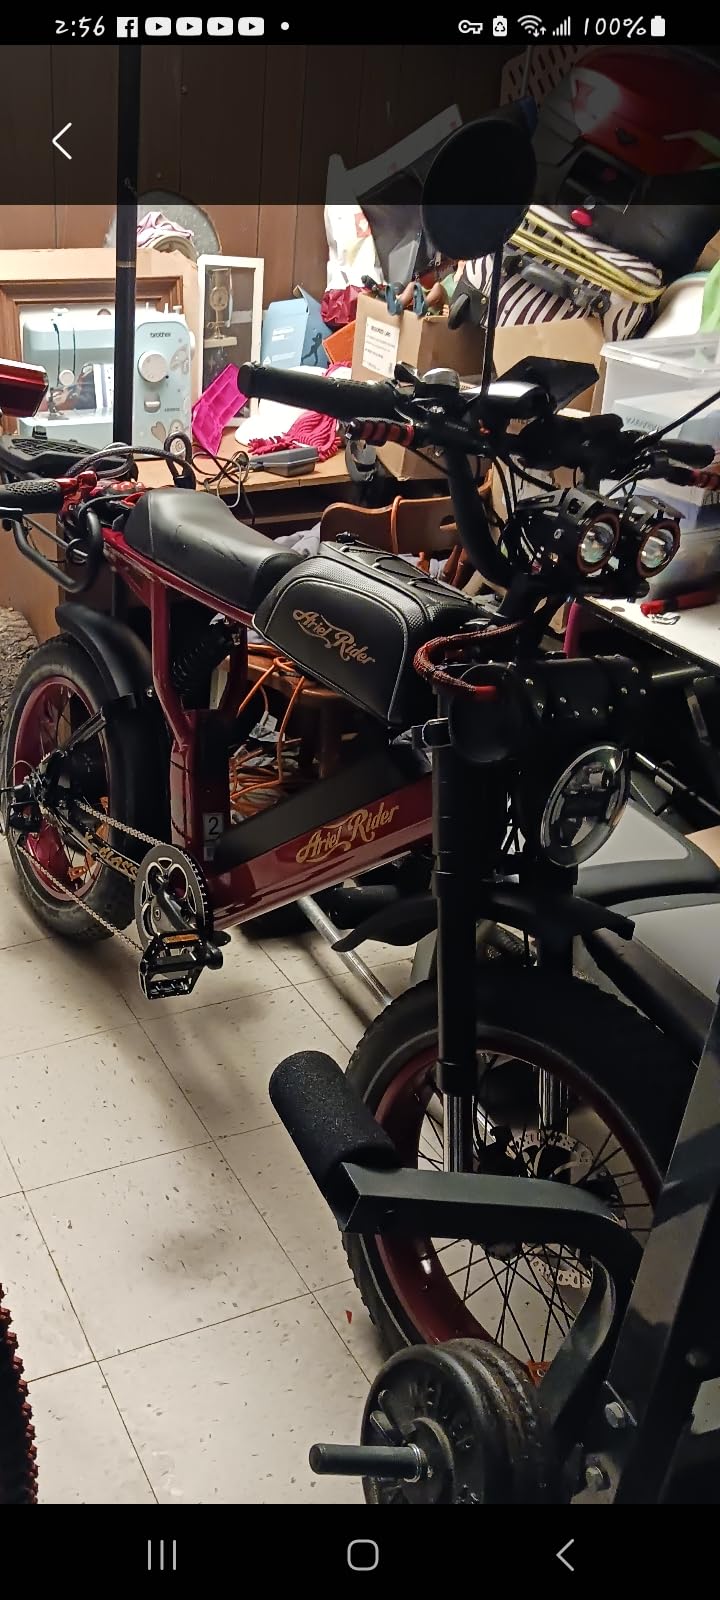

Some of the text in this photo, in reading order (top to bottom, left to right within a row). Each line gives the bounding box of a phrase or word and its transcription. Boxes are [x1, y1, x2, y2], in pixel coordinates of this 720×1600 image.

[292, 609, 376, 664] Ariel Rider
[208, 816, 219, 835] 2
[295, 802, 400, 864] Ariel Rider
